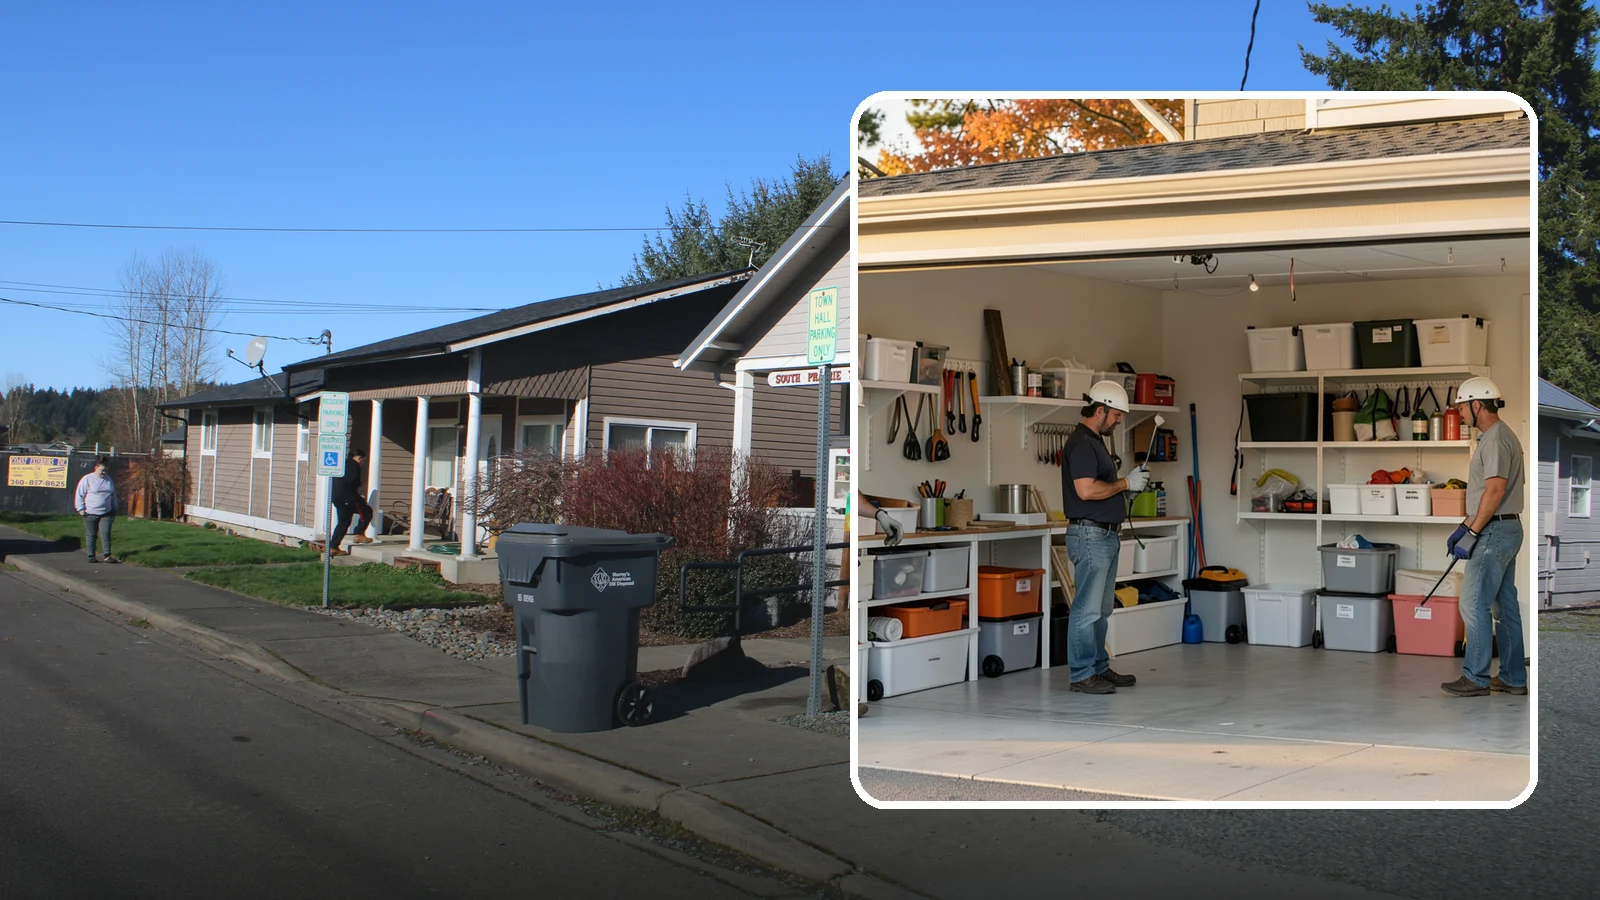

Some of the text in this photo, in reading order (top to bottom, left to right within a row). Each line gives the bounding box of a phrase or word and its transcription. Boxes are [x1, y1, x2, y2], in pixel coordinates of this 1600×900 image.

[815, 295, 833, 307] TOWN
[815, 312, 831, 324] HALL
[810, 327, 835, 340] PARKING
[814, 345, 830, 357] ONLY
[776, 374, 800, 384] SOUTH
